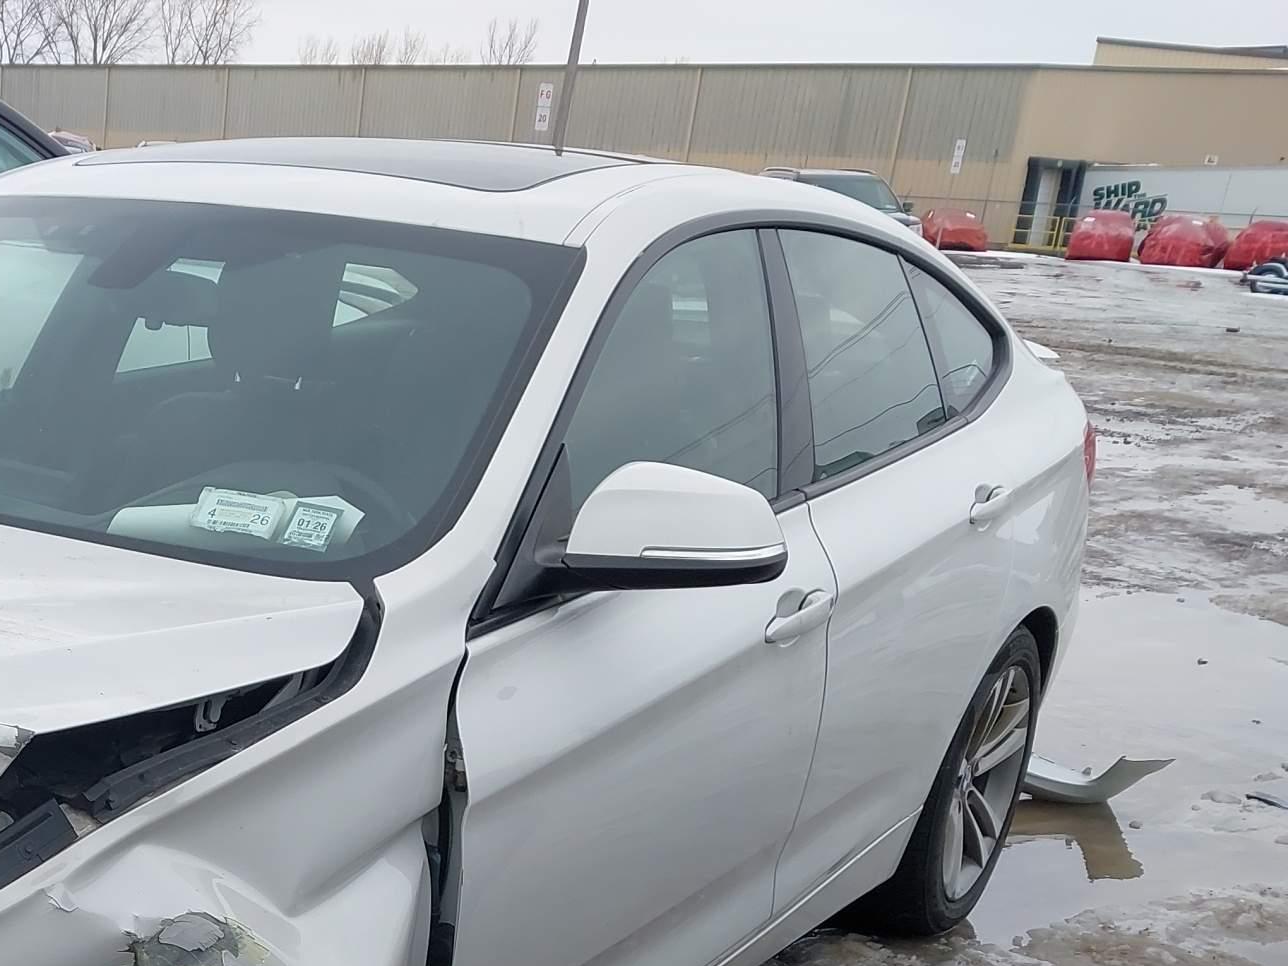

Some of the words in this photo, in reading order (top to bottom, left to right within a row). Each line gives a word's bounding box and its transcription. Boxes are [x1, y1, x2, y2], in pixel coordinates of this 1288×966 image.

[1093, 180, 1141, 201] SHIP
[208, 508, 217, 518] 4
[250, 513, 271, 526] 26
[297, 518, 311, 528] 01
[313, 521, 328, 531] 26
